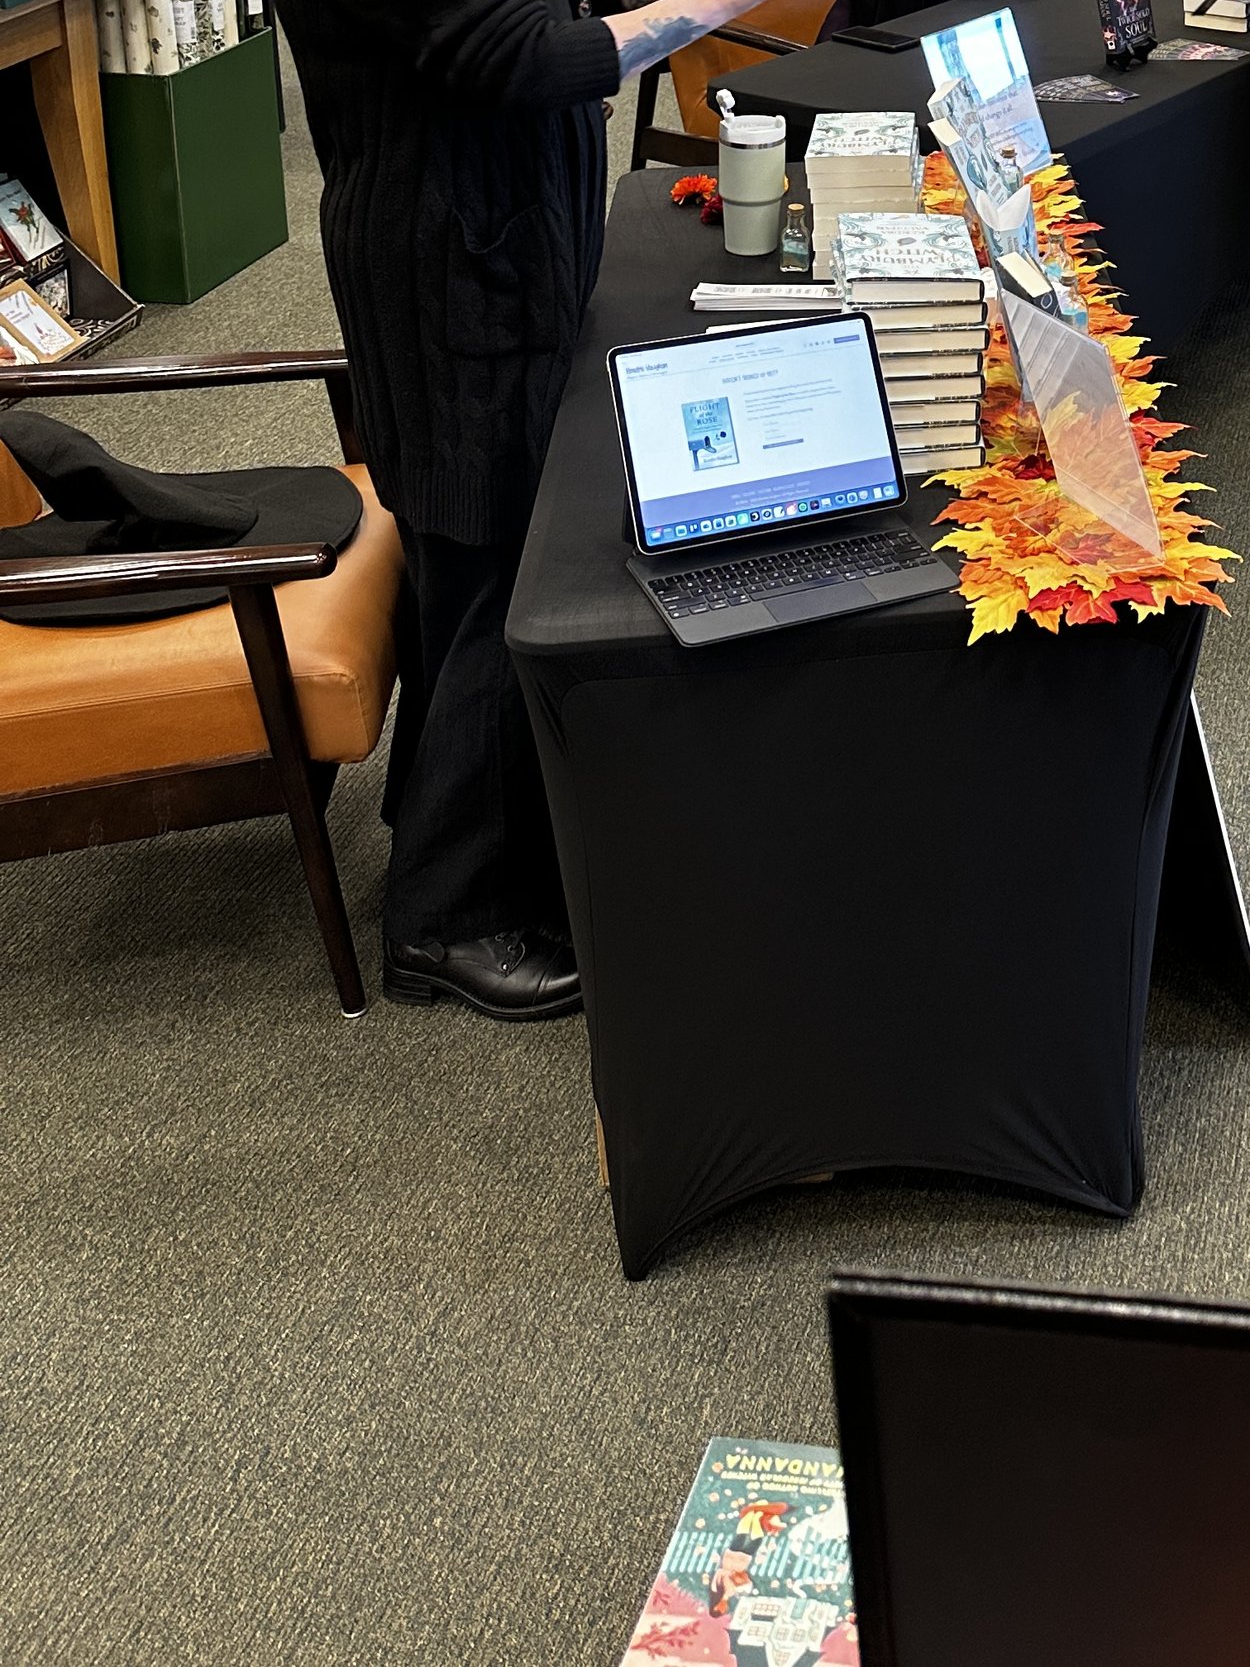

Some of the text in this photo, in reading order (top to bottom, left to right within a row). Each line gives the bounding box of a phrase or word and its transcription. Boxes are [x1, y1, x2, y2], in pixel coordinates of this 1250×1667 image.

[1124, 24, 1148, 39] SOUL
[858, 254, 960, 264] PLYMBURY
[689, 402, 720, 414] FLIGHT
[696, 416, 718, 426] ROSE
